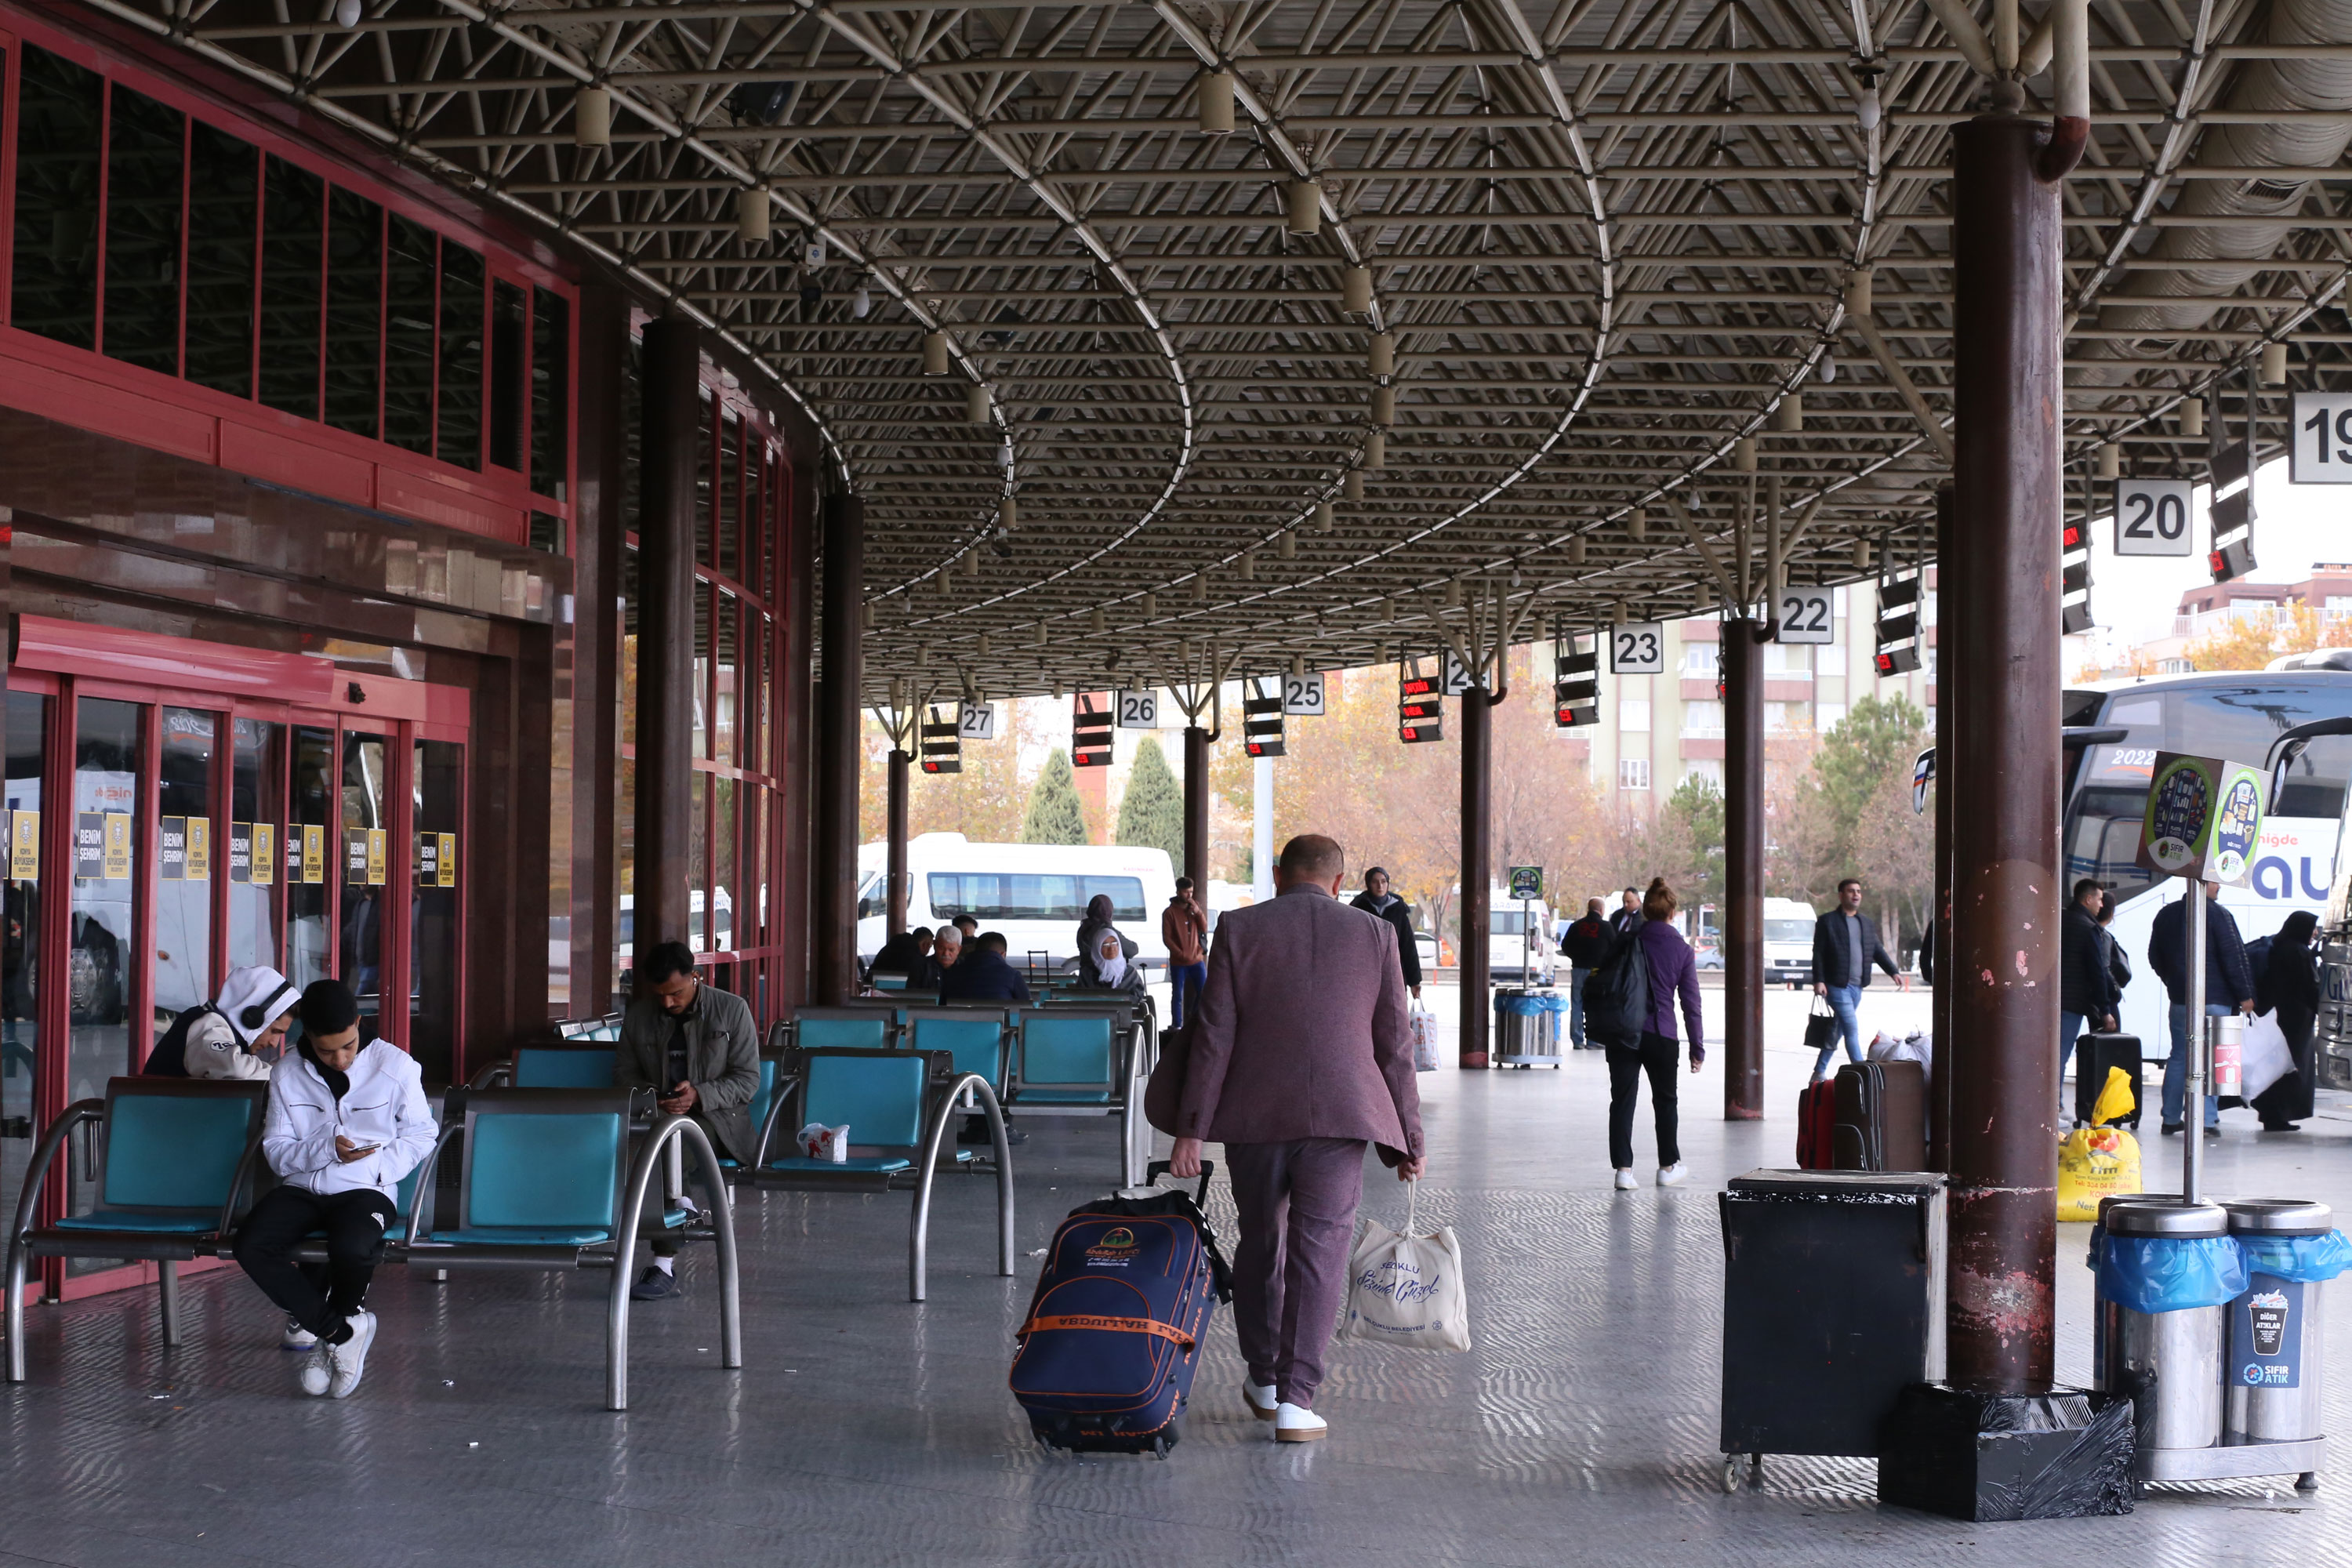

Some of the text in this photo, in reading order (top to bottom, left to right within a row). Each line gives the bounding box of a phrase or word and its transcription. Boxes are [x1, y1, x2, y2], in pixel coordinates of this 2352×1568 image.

[2124, 492, 2185, 540] 20
[1782, 597, 1828, 632] 22
[1617, 633, 1658, 663] 23
[1287, 681, 1321, 706] 25
[1123, 698, 1154, 721] 26
[963, 709, 990, 731] 27
[2111, 749, 2157, 765] 2022
[80, 829, 101, 844] BENİM
[163, 833, 183, 847] BENİM
[2259, 833, 2299, 848] niğde
[231, 838, 249, 851] BENİM
[288, 840, 300, 852] ENİM
[350, 842, 365, 855] BENİM
[2169, 843, 2184, 853] SIFIR
[79, 847, 100, 862] ŞEHRİM
[163, 850, 183, 864] ŞEHRİM
[421, 846, 436, 858] BENİM
[350, 858, 365, 870] ŞEHRİM
[421, 861, 435, 873] ŞEHRİM
[2076, 1200, 2096, 1212] Net:
[1396, 1274, 1440, 1305] Güzel
[2259, 1312, 2278, 1321] DİĞER
[1391, 1323, 1425, 1332] BELEDİYESİ
[2264, 1365, 2289, 1374] SIFIR
[2264, 1374, 2288, 1384] ATIK
